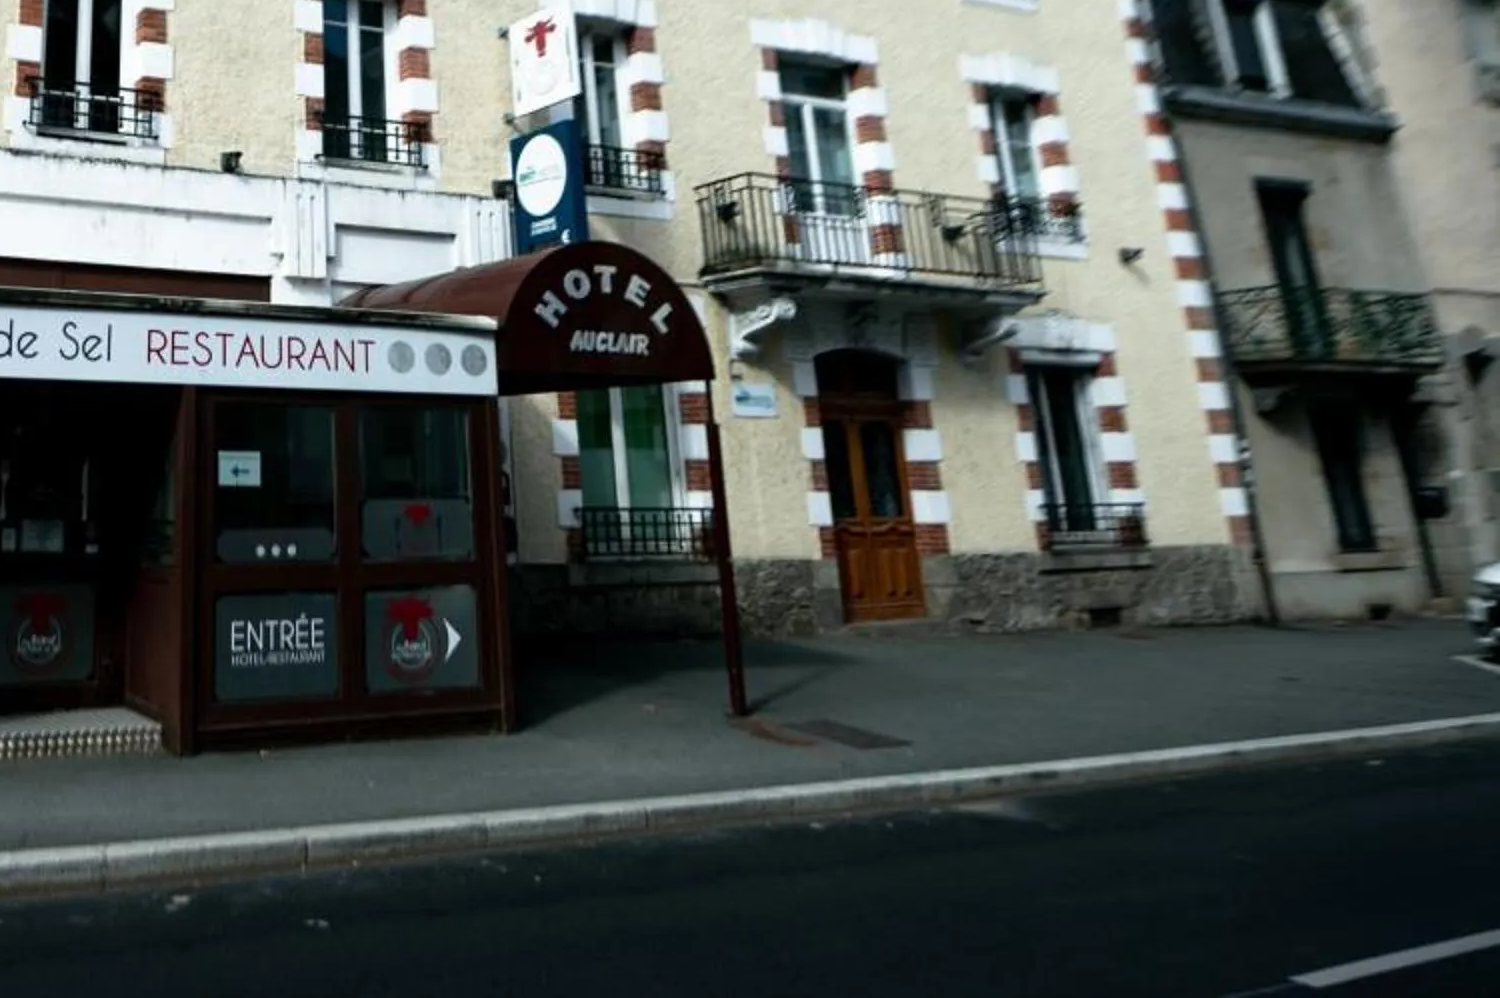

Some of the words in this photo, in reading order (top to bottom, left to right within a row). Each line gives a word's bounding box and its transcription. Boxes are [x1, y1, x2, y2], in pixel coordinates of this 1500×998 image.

[534, 264, 673, 334] HOTEL
[59, 321, 112, 363] Sel
[146, 328, 376, 373] RESTAURANT
[570, 329, 650, 356] AUCLAIR
[231, 612, 325, 652] ENTRÉE
